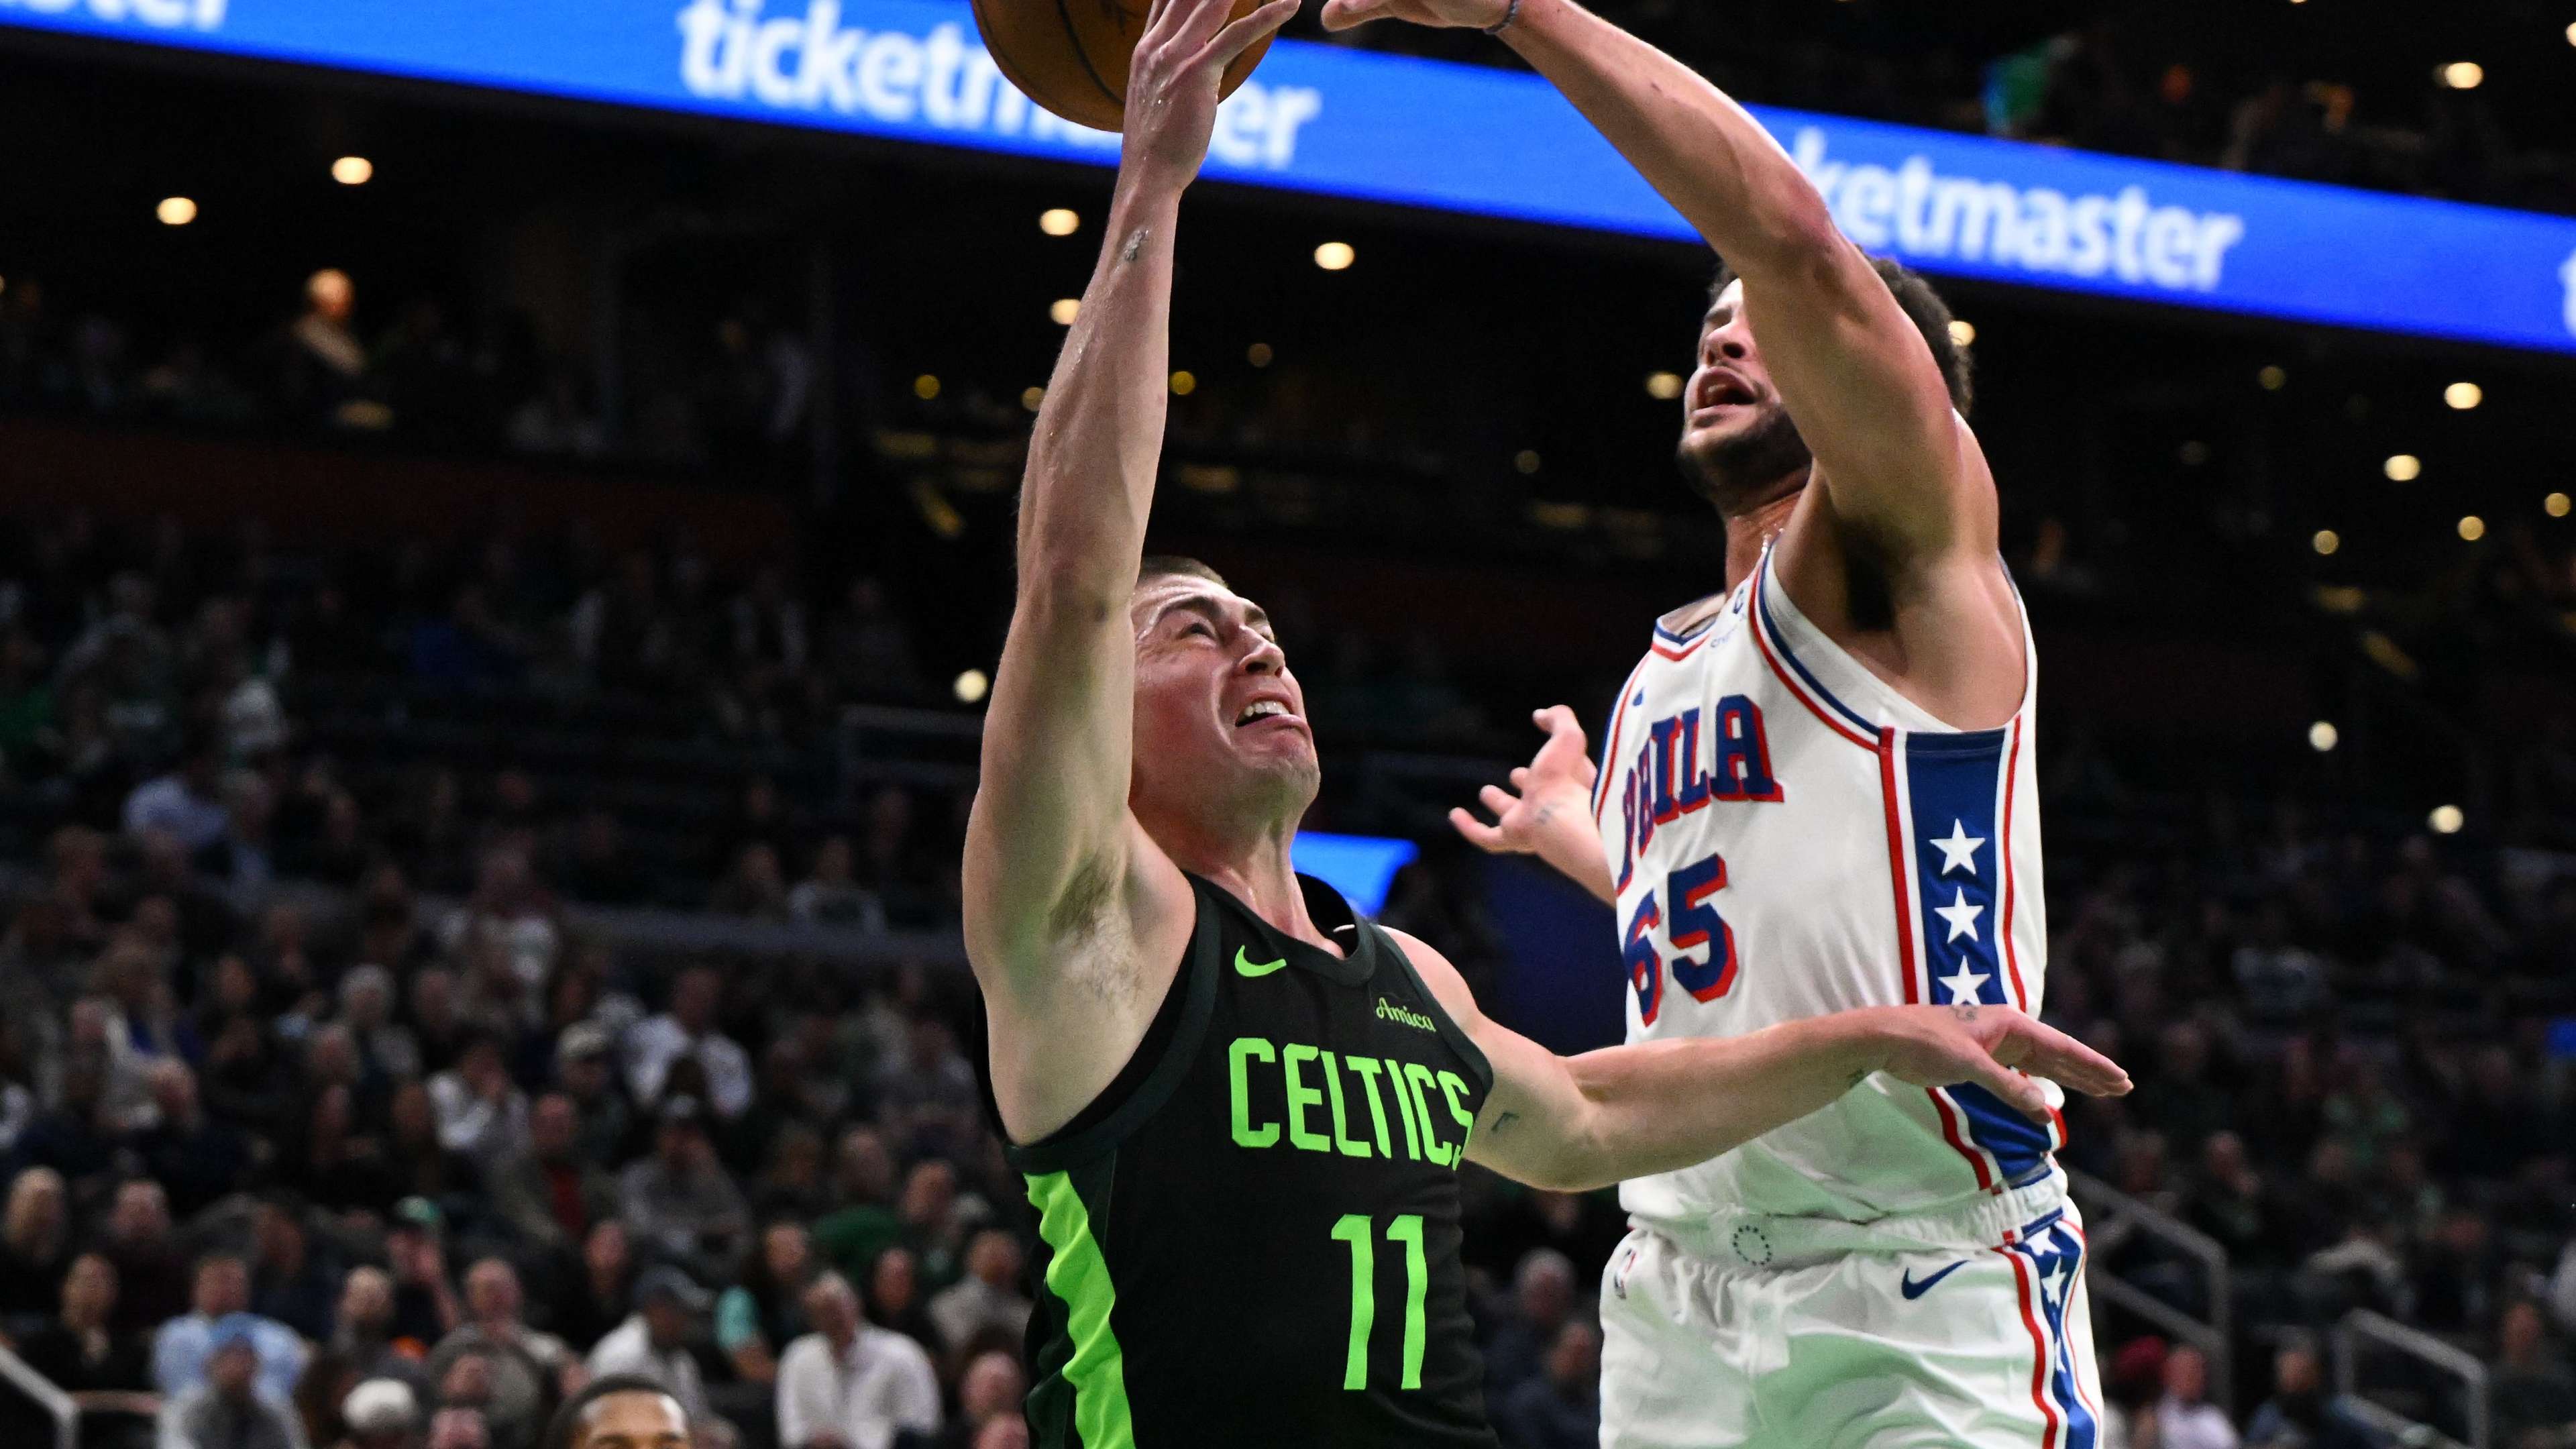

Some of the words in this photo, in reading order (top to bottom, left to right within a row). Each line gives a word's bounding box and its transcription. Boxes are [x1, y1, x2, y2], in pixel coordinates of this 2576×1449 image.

[679, 0, 1321, 166] ticketmer
[1794, 127, 2242, 290] ketmaster
[1616, 694, 1784, 897] PHILA
[1376, 997, 1436, 1032] Amica
[1623, 852, 1737, 1027] 65
[1228, 1037, 1473, 1171] CELTICS
[1331, 1214, 1428, 1390] 11
